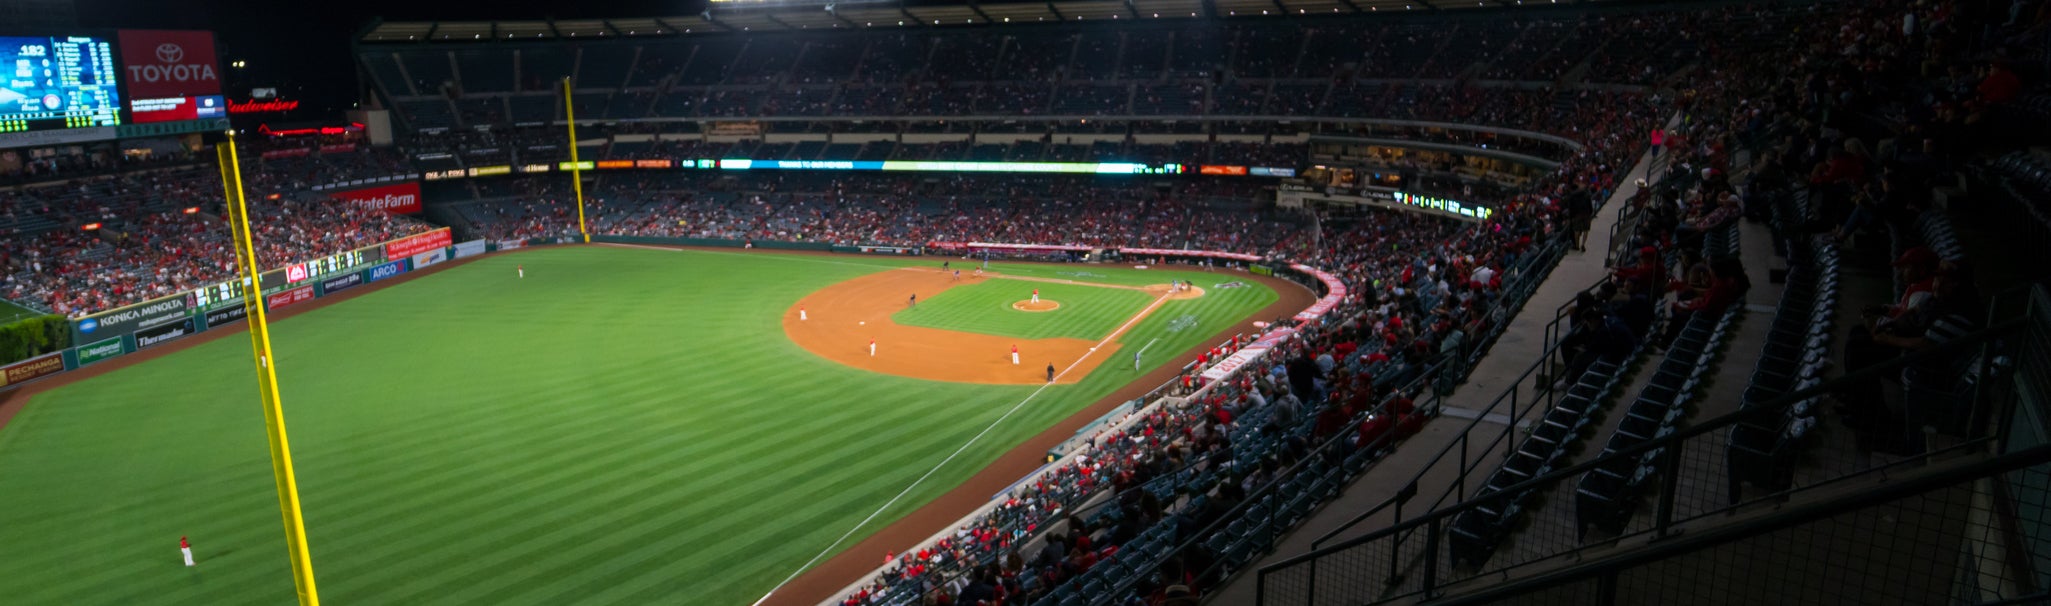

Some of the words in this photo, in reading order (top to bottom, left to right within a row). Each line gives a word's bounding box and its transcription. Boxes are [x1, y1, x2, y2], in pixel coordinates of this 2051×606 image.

[128, 64, 216, 82] TOYOTA
[373, 264, 396, 278] ARCO
[100, 310, 140, 327] KONICA
[141, 299, 183, 316] MINOLTA
[138, 328, 184, 348] Thermador
[89, 341, 120, 356] National
[8, 358, 60, 376] PECHANGA
[1214, 354, 1249, 372] 2017
